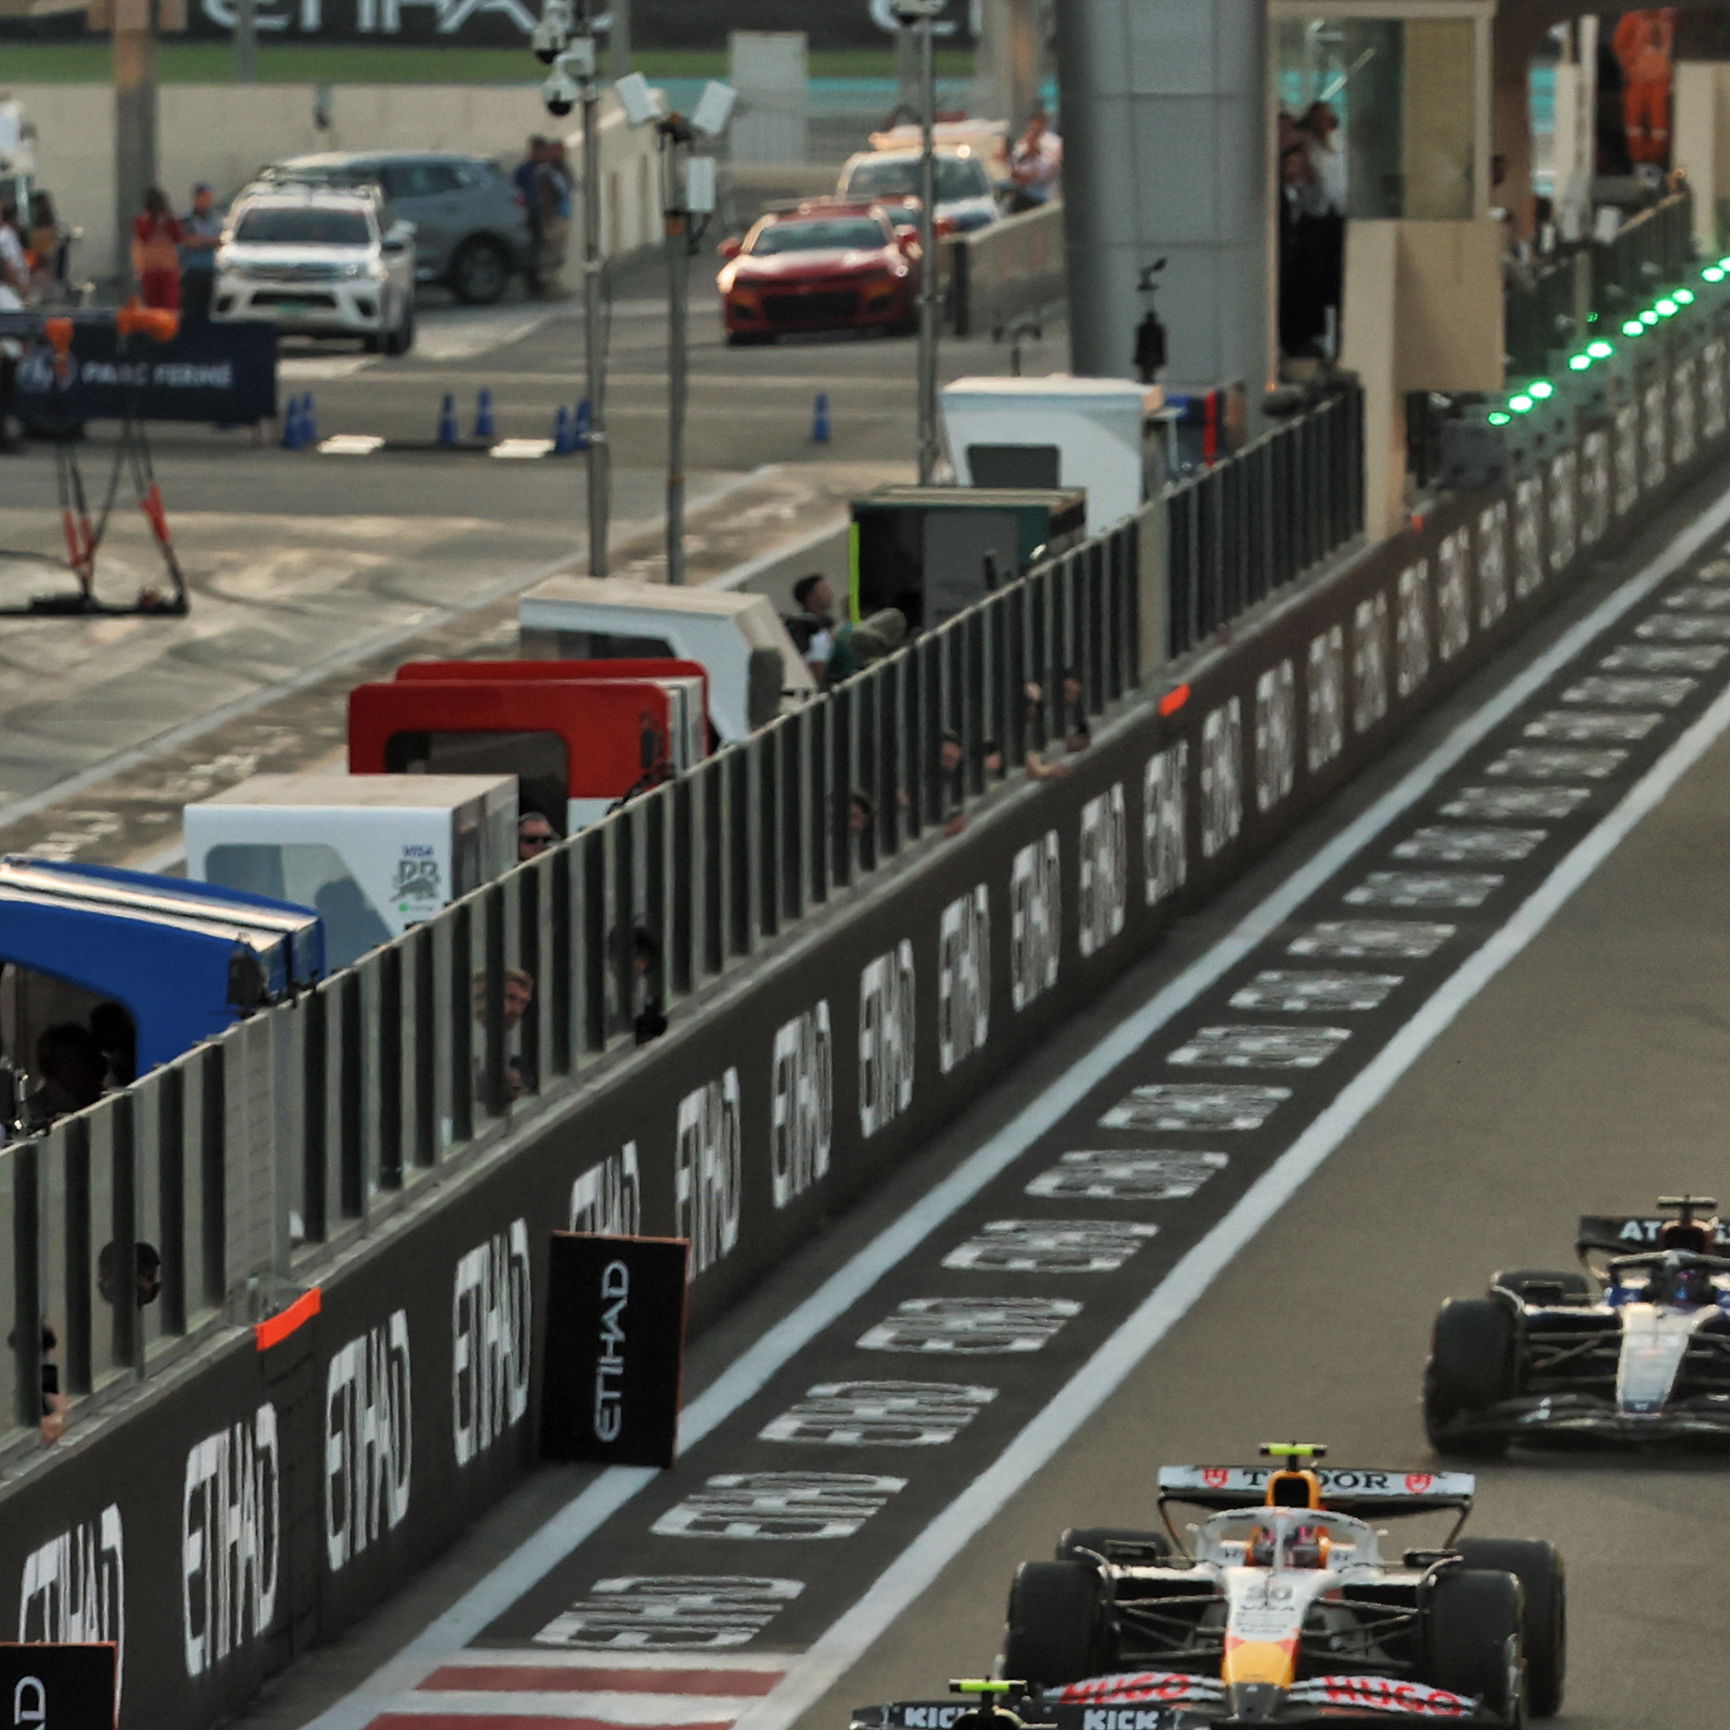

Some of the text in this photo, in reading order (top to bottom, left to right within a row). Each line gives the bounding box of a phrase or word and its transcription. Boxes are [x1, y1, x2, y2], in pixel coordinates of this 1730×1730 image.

[453, 1217, 532, 1468] ETIHAD
[594, 1259, 629, 1443] ETIHAD
[325, 1308, 411, 1571] ETIHAD
[1242, 1469, 1390, 1491] TDOR
[182, 1403, 278, 1678] ETIHAD
[903, 1706, 975, 1730] KIC
[1058, 1672, 1464, 1717] HUGO HUGO
